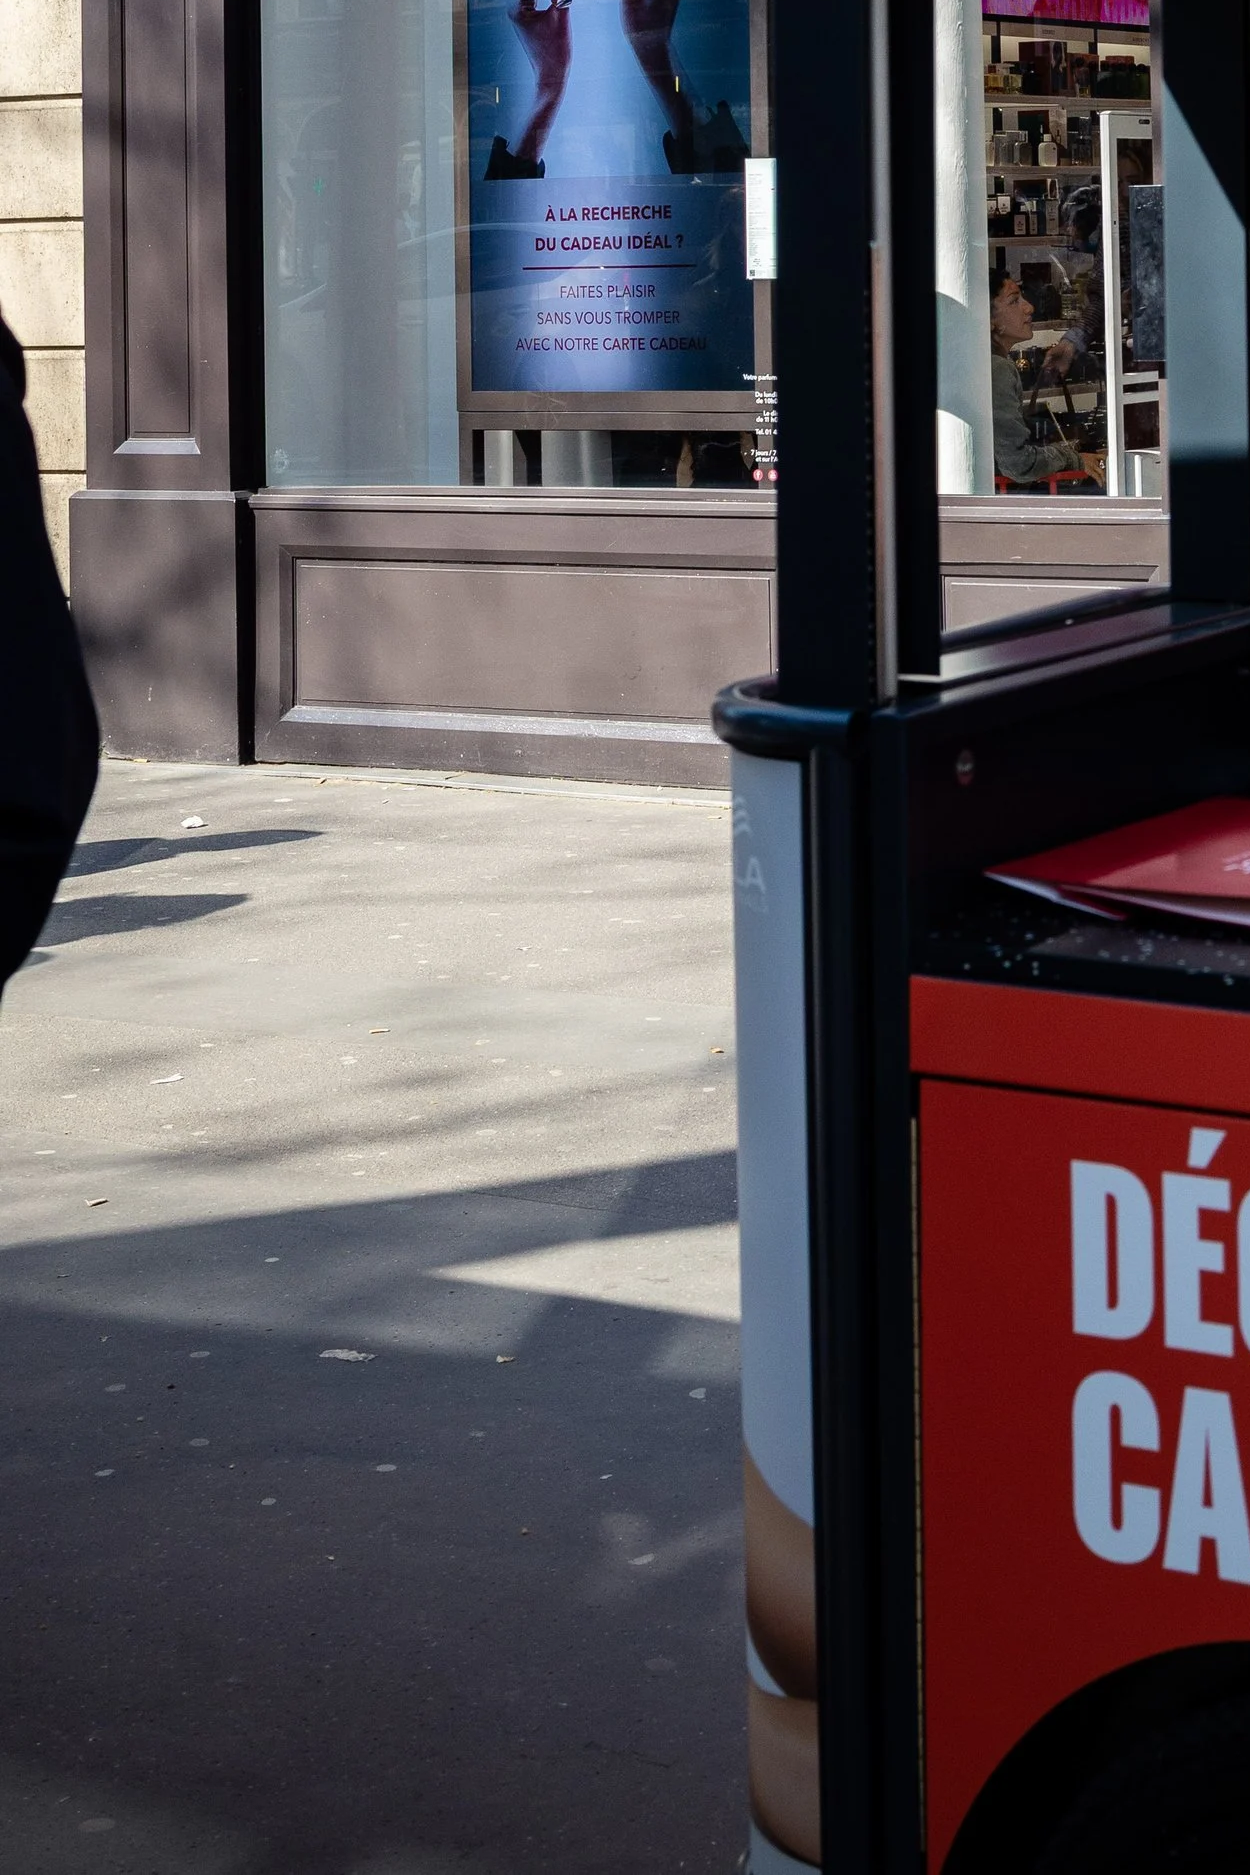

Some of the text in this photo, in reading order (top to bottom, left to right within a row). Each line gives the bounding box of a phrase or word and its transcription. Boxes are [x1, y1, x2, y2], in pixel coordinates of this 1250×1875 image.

[545, 204, 673, 222] À LA RECHERCHE
[535, 232, 684, 252] DU CADEAU IDÉAL ?
[560, 284, 656, 299] FAITES PLAISIR
[537, 311, 681, 325] SANS VOUS TROMPER
[515, 337, 708, 351] AVEC NOTRE CARTE CADEAU
